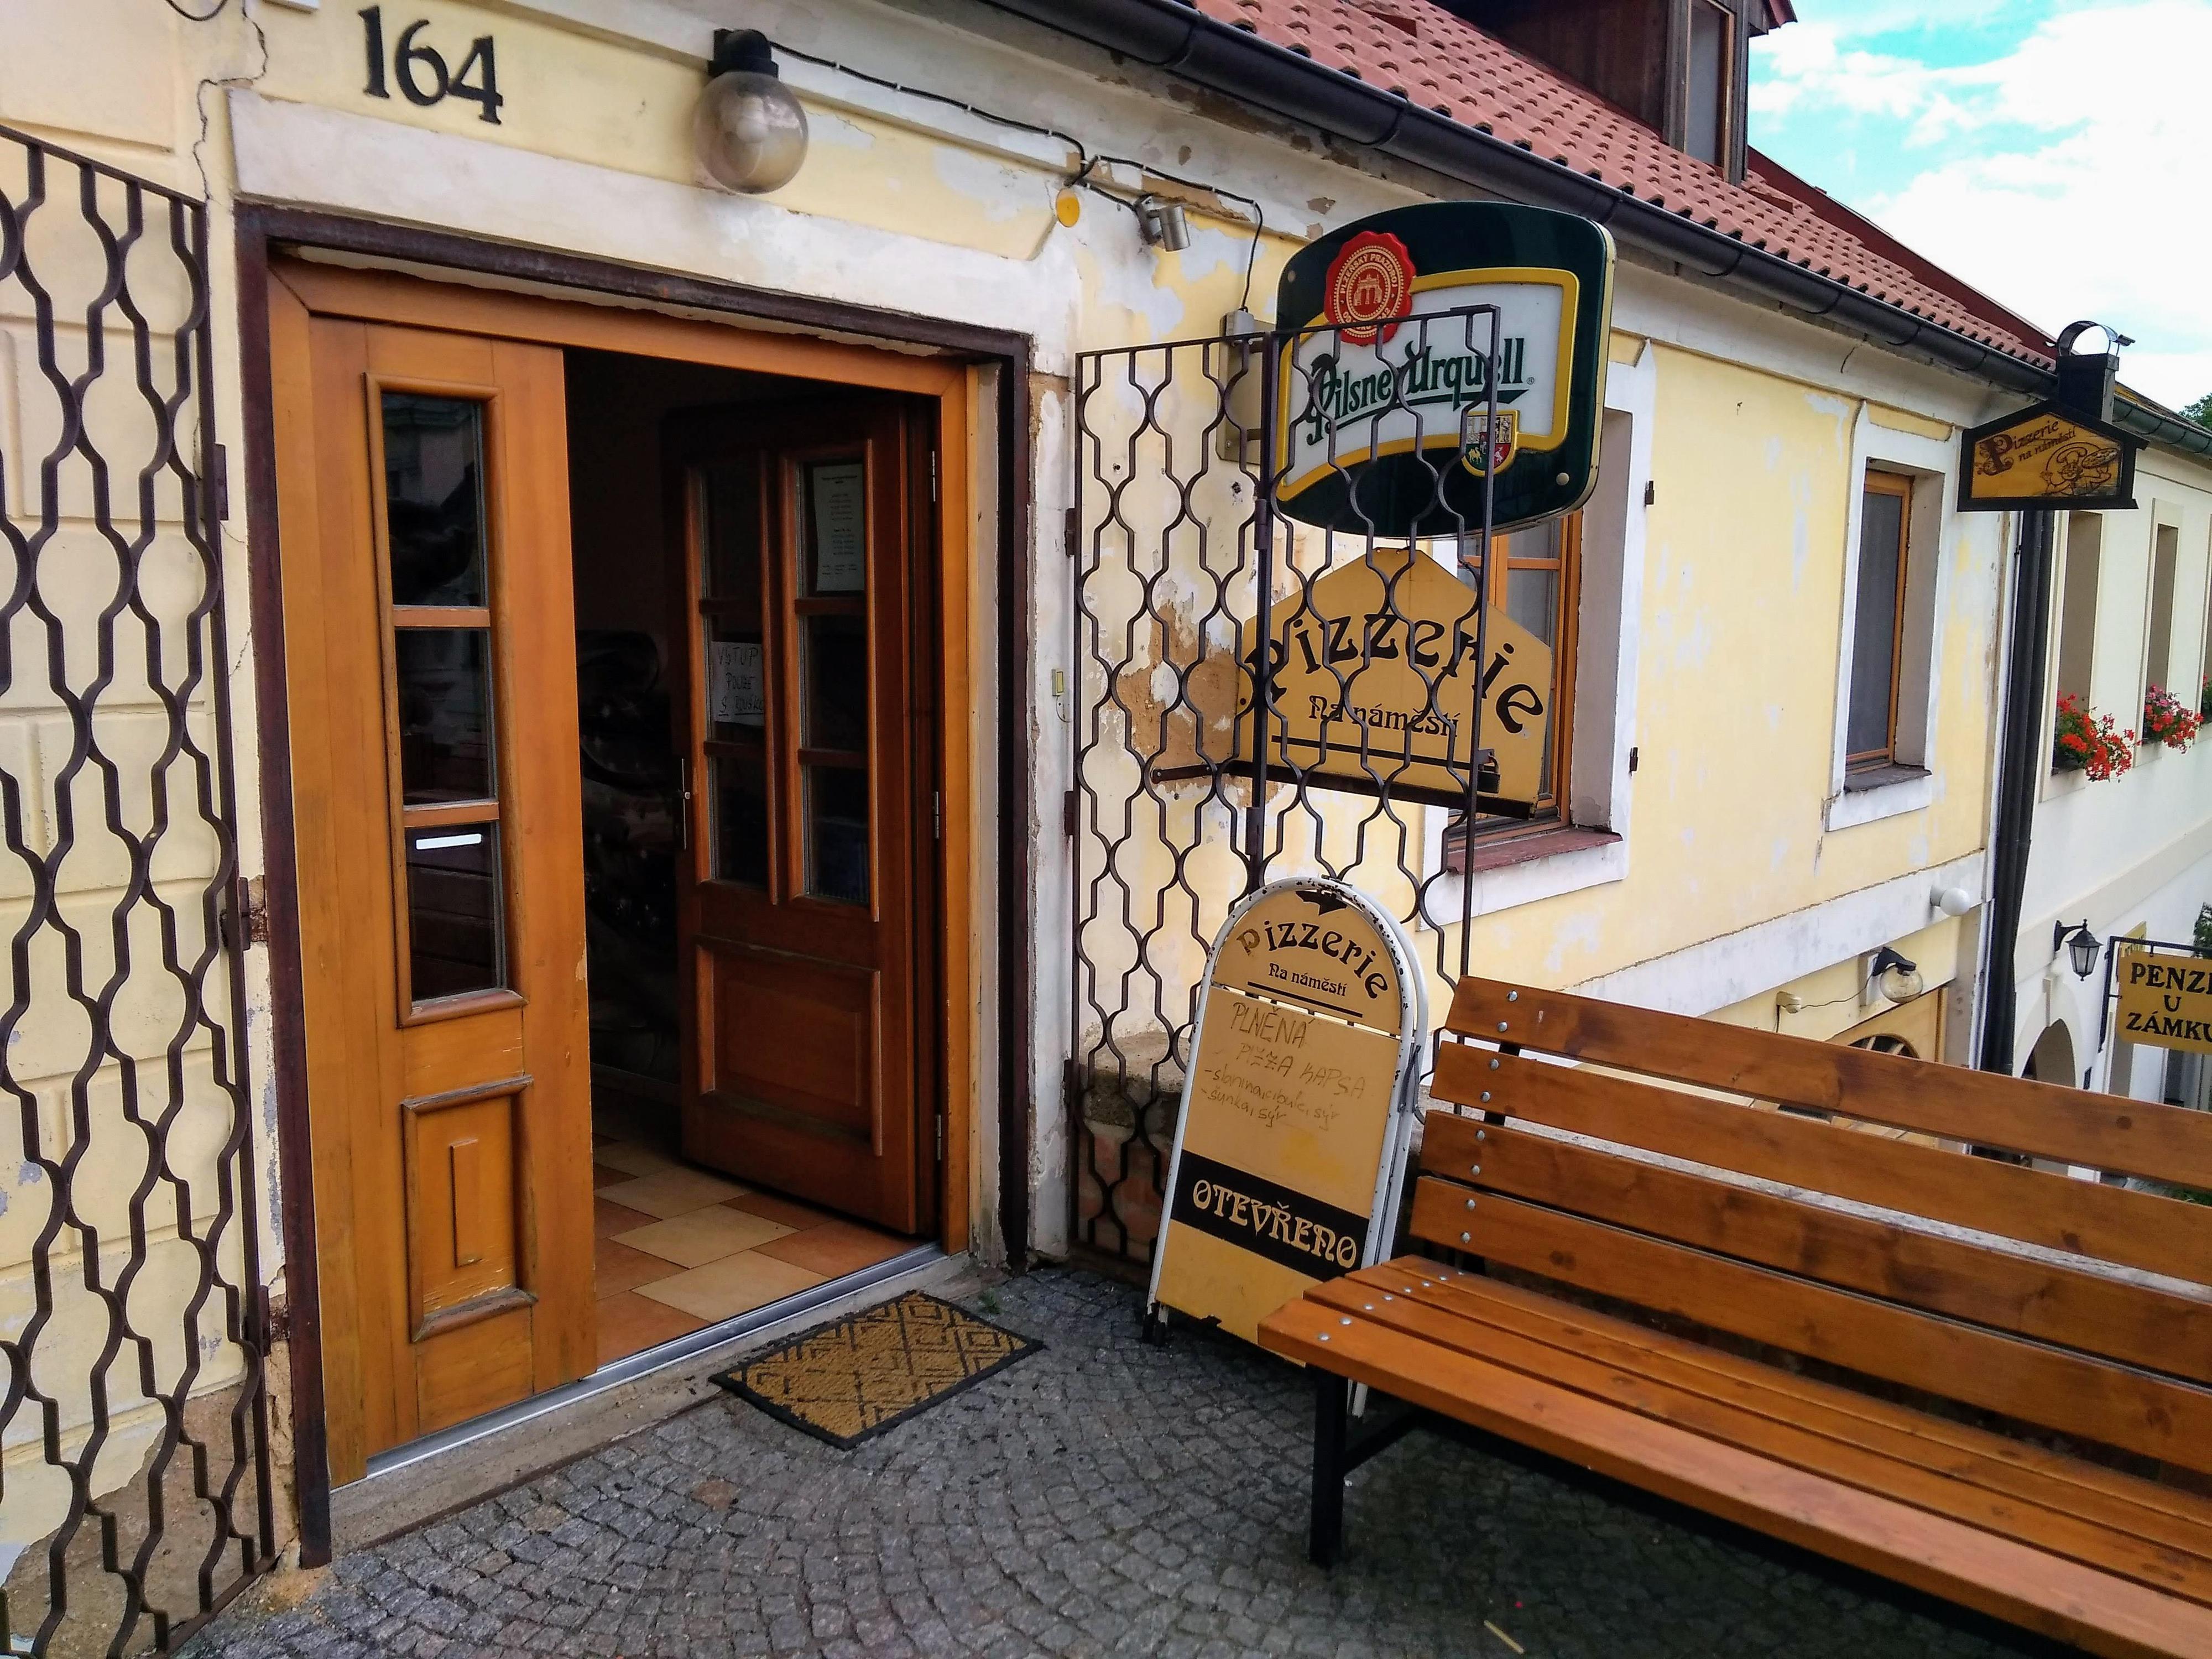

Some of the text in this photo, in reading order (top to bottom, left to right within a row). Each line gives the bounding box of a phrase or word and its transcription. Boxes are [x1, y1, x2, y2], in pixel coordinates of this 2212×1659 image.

[358, 6, 503, 124] 164
[1370, 253, 1398, 288] PRAZDROJ
[1306, 338, 1525, 446] Pilsne Urqull
[1976, 420, 2059, 476] Pizzerie
[2019, 451, 2032, 461] na
[1268, 962, 1348, 997] Na náměstí
[2163, 994, 2182, 1012] U
[1231, 1002, 1316, 1048] PLNĚNÁ
[1300, 1062, 1365, 1099] KAPSA
[1258, 1105, 1287, 1128] sýr
[1193, 1180, 1357, 1269] OTEVŘENO
